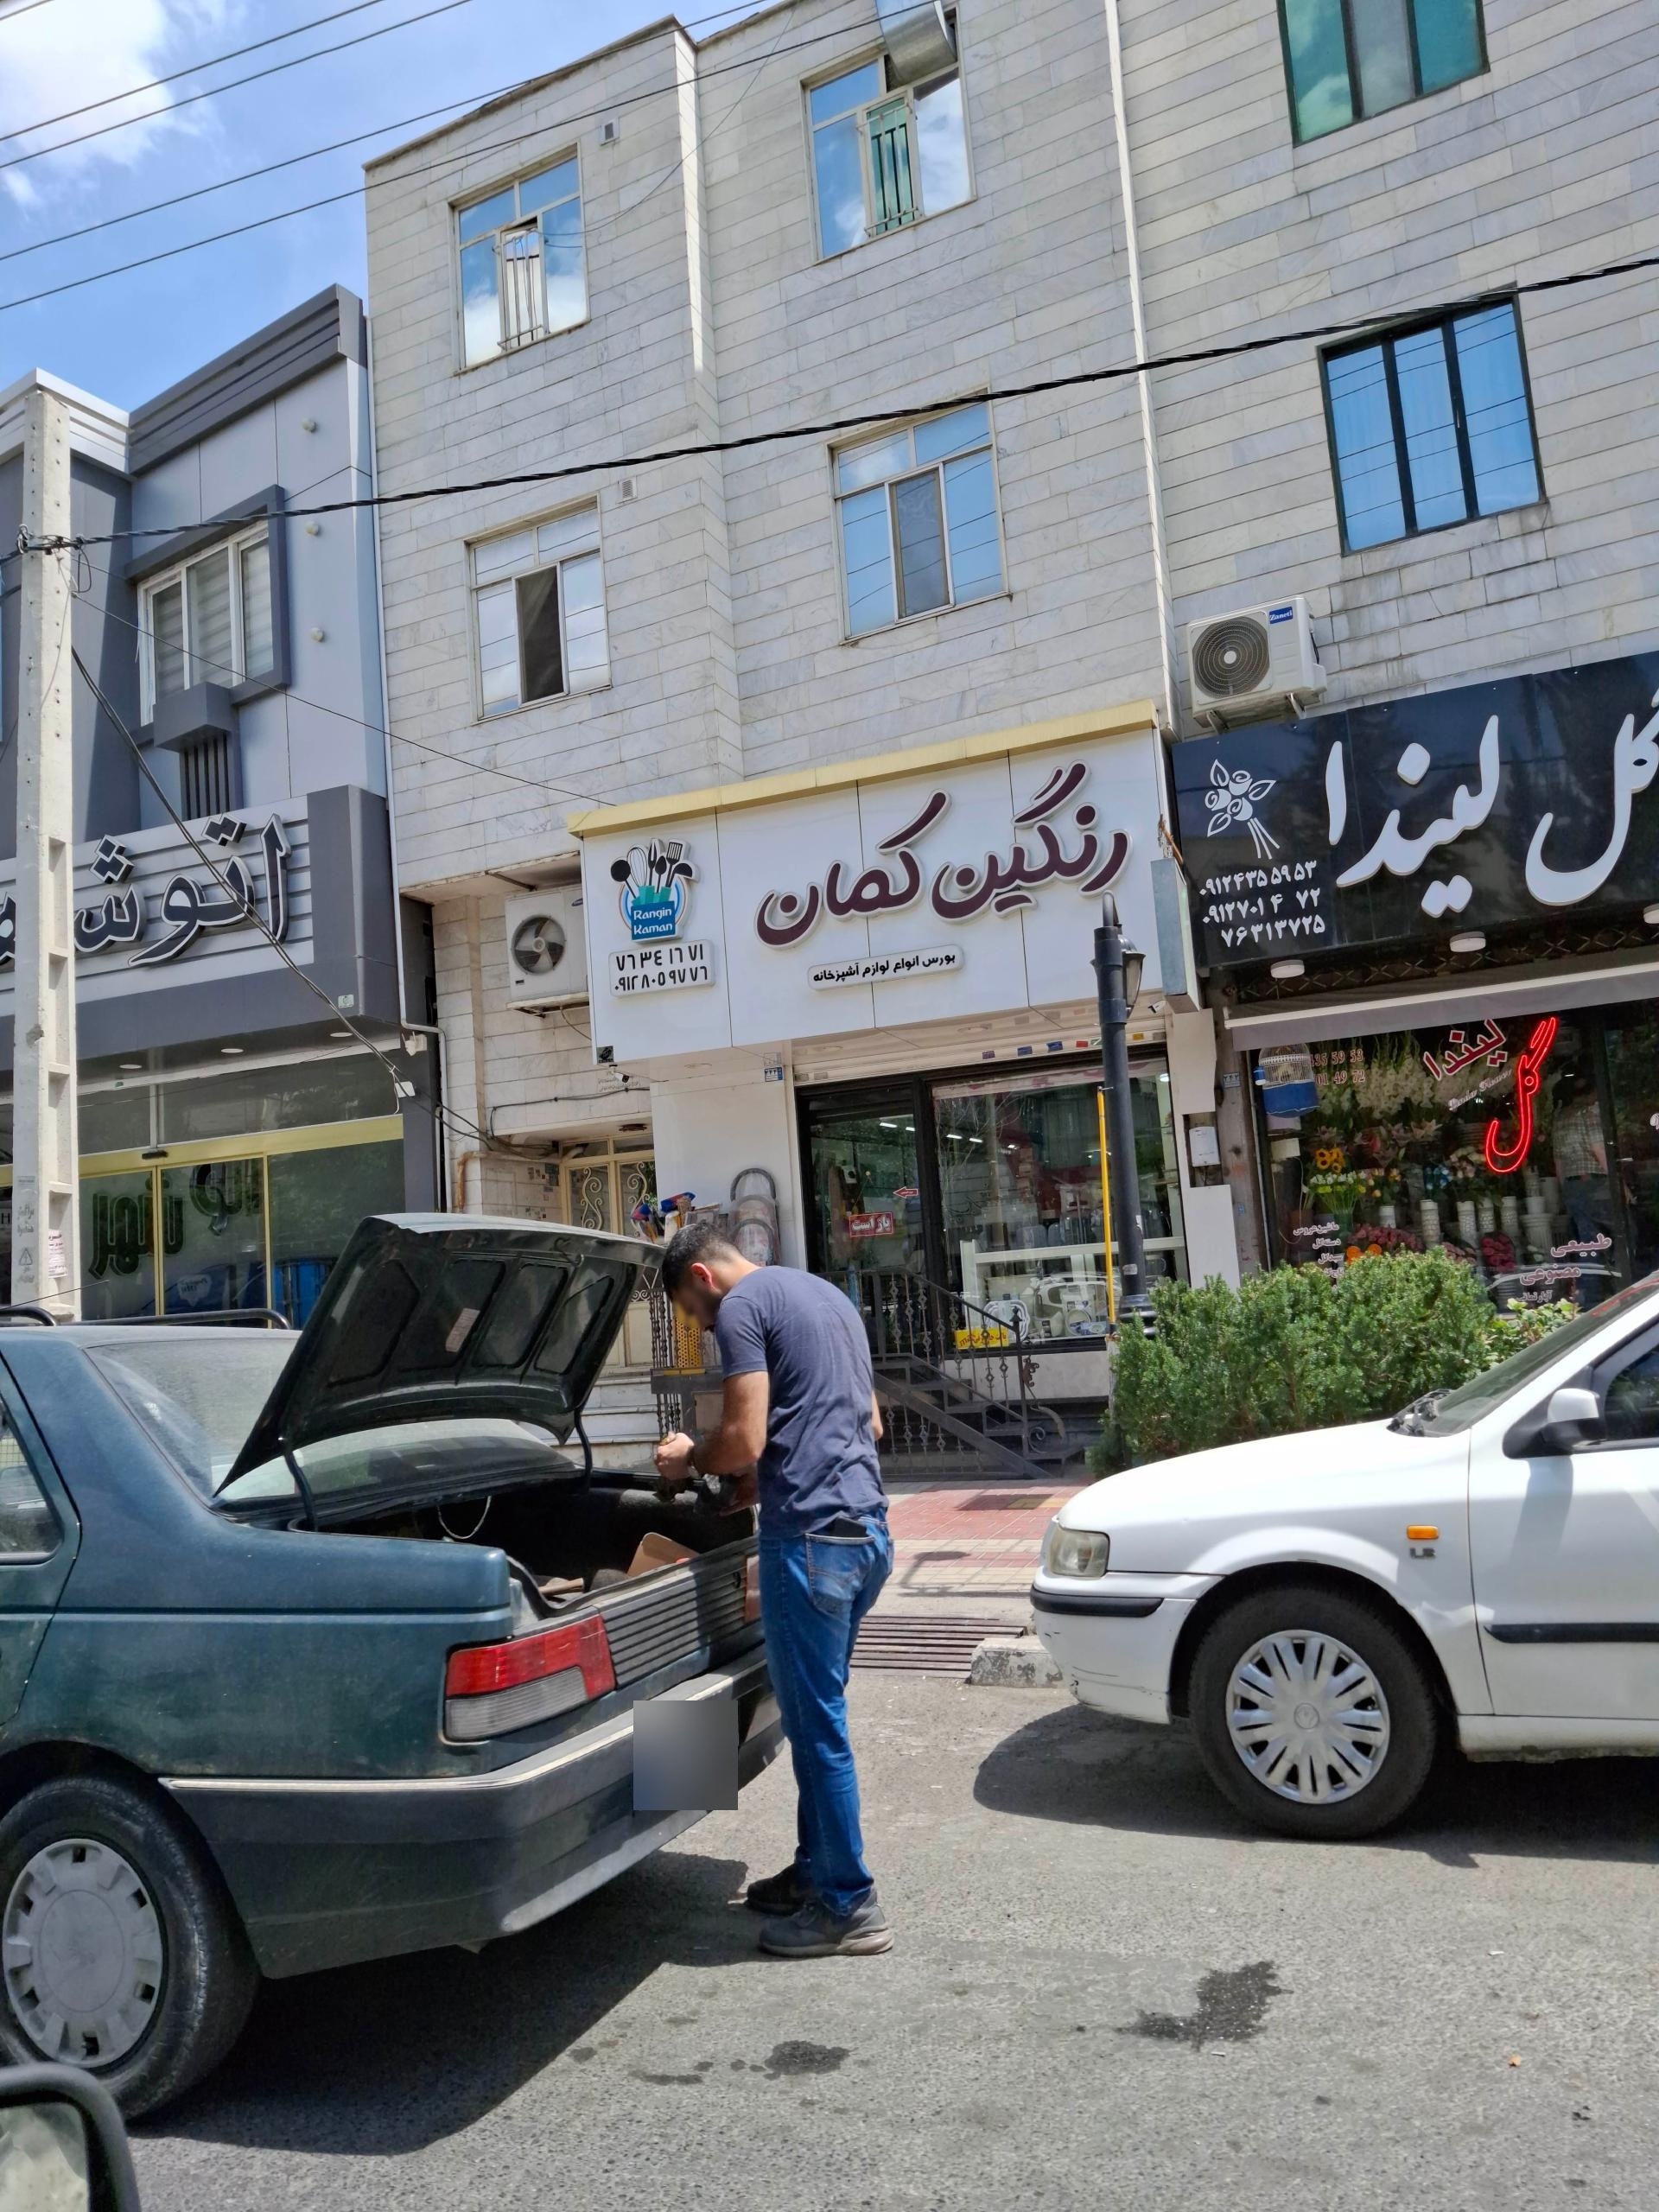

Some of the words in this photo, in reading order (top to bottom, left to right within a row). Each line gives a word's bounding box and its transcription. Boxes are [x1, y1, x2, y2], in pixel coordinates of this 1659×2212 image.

[1325, 715, 1500, 918] لیندا
[931, 760, 1133, 922] رنگین
[754, 790, 950, 948] کمان
[633, 907, 672, 920] Rangin
[633, 923, 673, 935] Kaman
[862, 960, 890, 977] لوازم
[893, 956, 919, 974] انواع
[921, 954, 957, 968] بورس
[813, 963, 860, 982] آشپزخانه
[1331, 1050, 1345, 1065] 59
[1350, 1048, 1363, 1063] 53
[1333, 1071, 1348, 1084] 49
[1352, 1069, 1366, 1084] 72
[1484, 1016, 1557, 1173] گل
[851, 1215, 874, 1231] است
[875, 1213, 891, 1233] باز
[1551, 1232, 1612, 1257] طبیعی
[1520, 1262, 1582, 1286] مصنوعی
